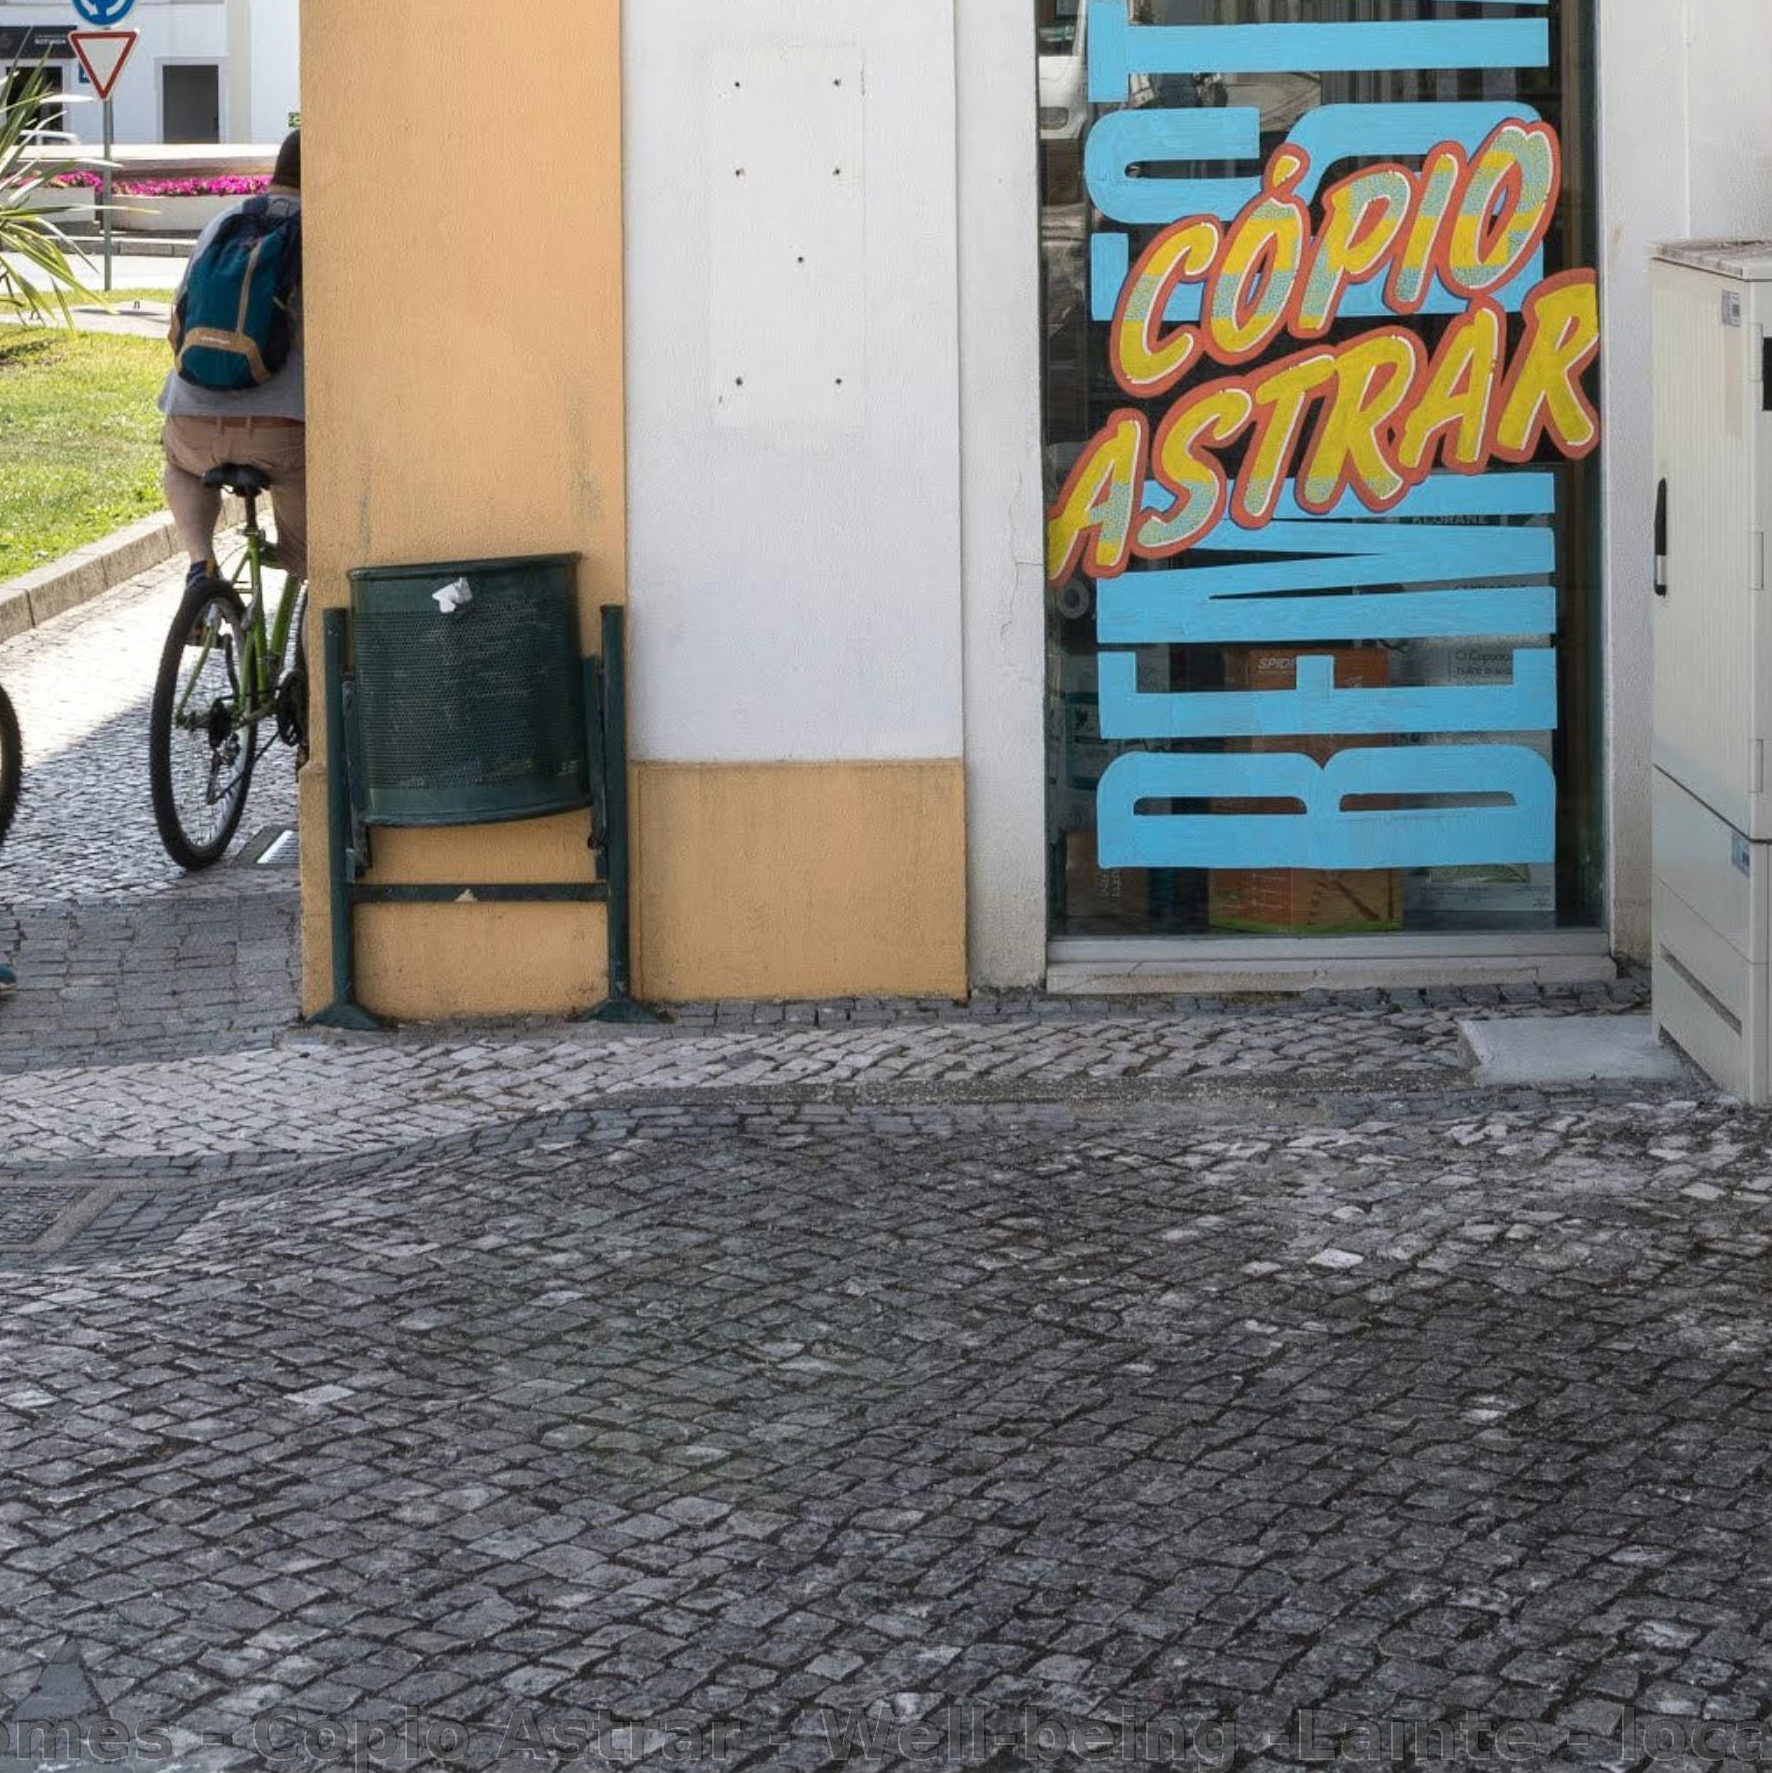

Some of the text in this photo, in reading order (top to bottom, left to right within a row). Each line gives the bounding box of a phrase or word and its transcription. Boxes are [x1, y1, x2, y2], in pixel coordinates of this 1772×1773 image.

[1111, 117, 1561, 395] CÓPIO
[1048, 267, 1599, 577] ASTRAR
[1096, 471, 1557, 868] BEM
